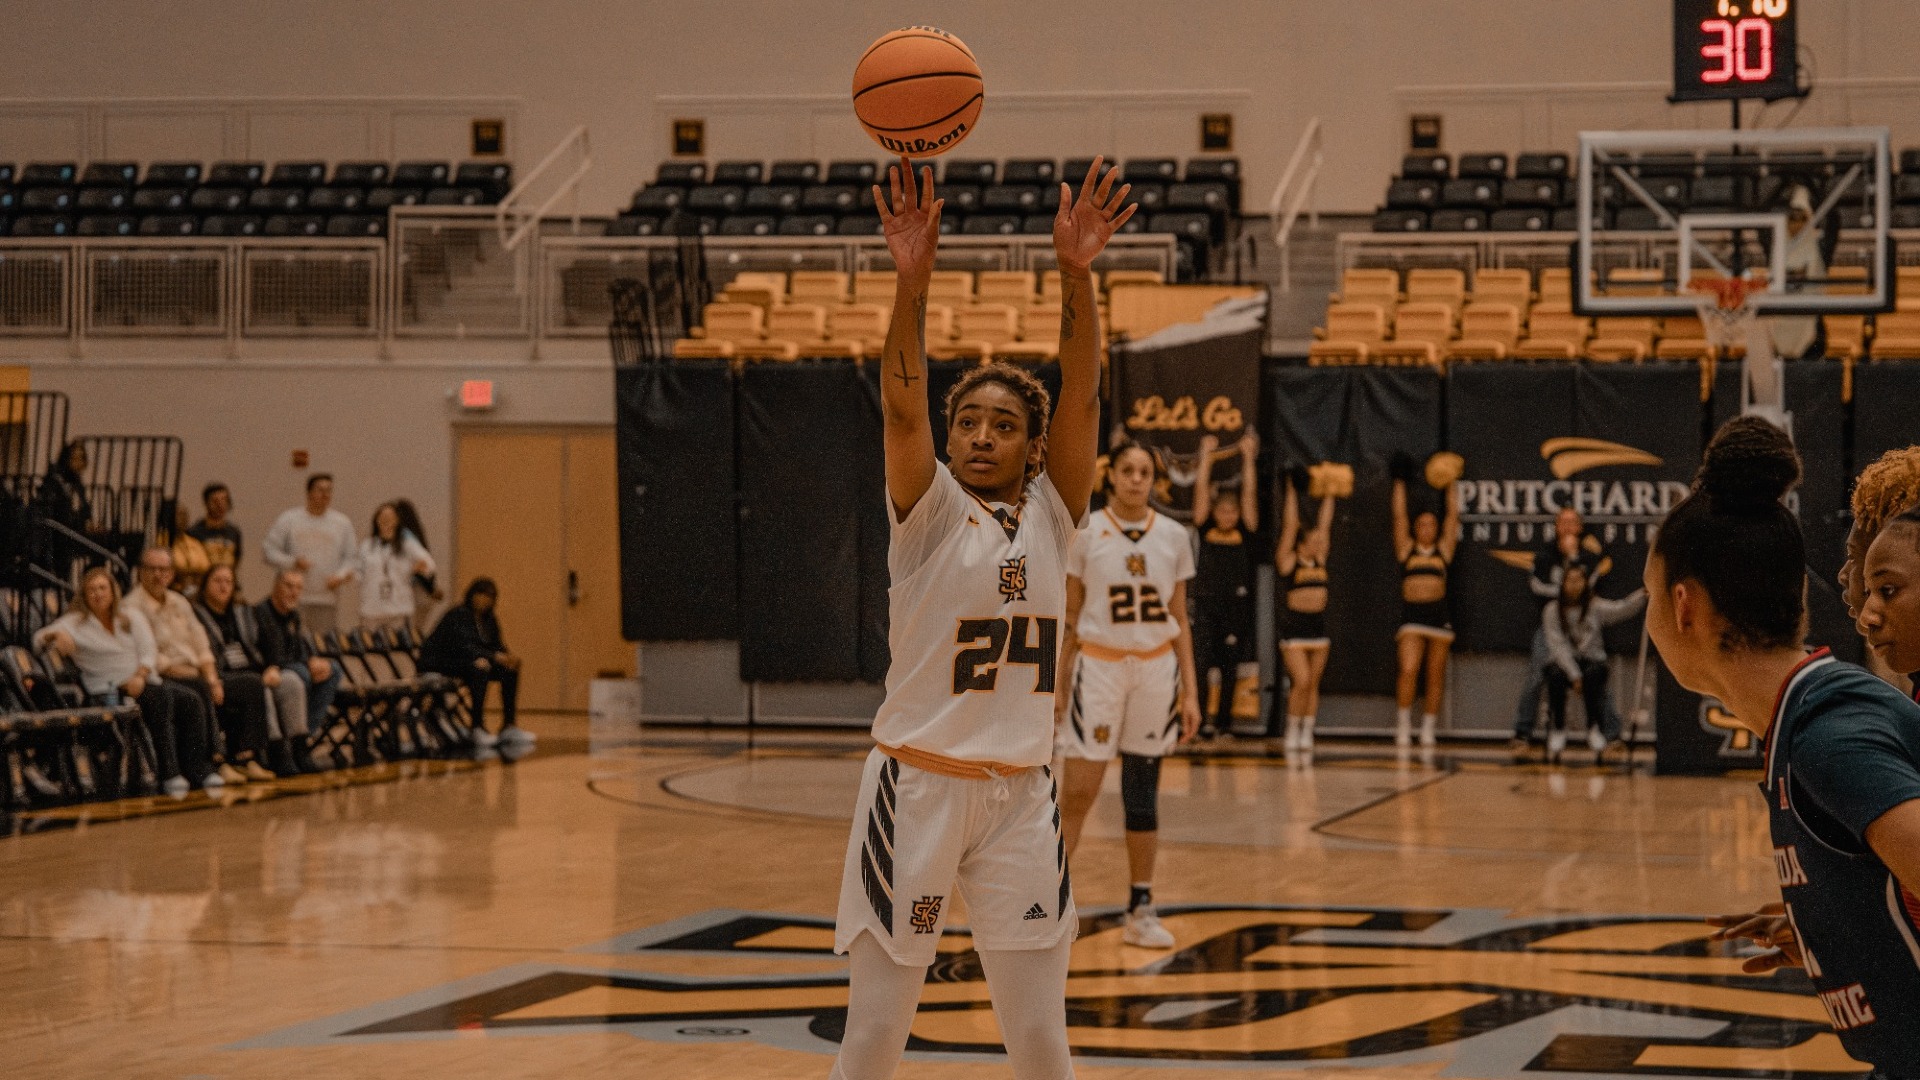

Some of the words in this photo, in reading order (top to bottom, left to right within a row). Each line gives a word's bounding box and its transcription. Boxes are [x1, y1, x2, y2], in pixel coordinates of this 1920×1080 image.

[1700, 18, 1772, 83] 30
[877, 122, 968, 154] Wilson
[1202, 394, 1244, 432] Go
[1457, 478, 1692, 516] PRITCHARD
[1107, 583, 1169, 624] 22
[950, 613, 1058, 697] 24
[1023, 912, 1048, 921] adidas
